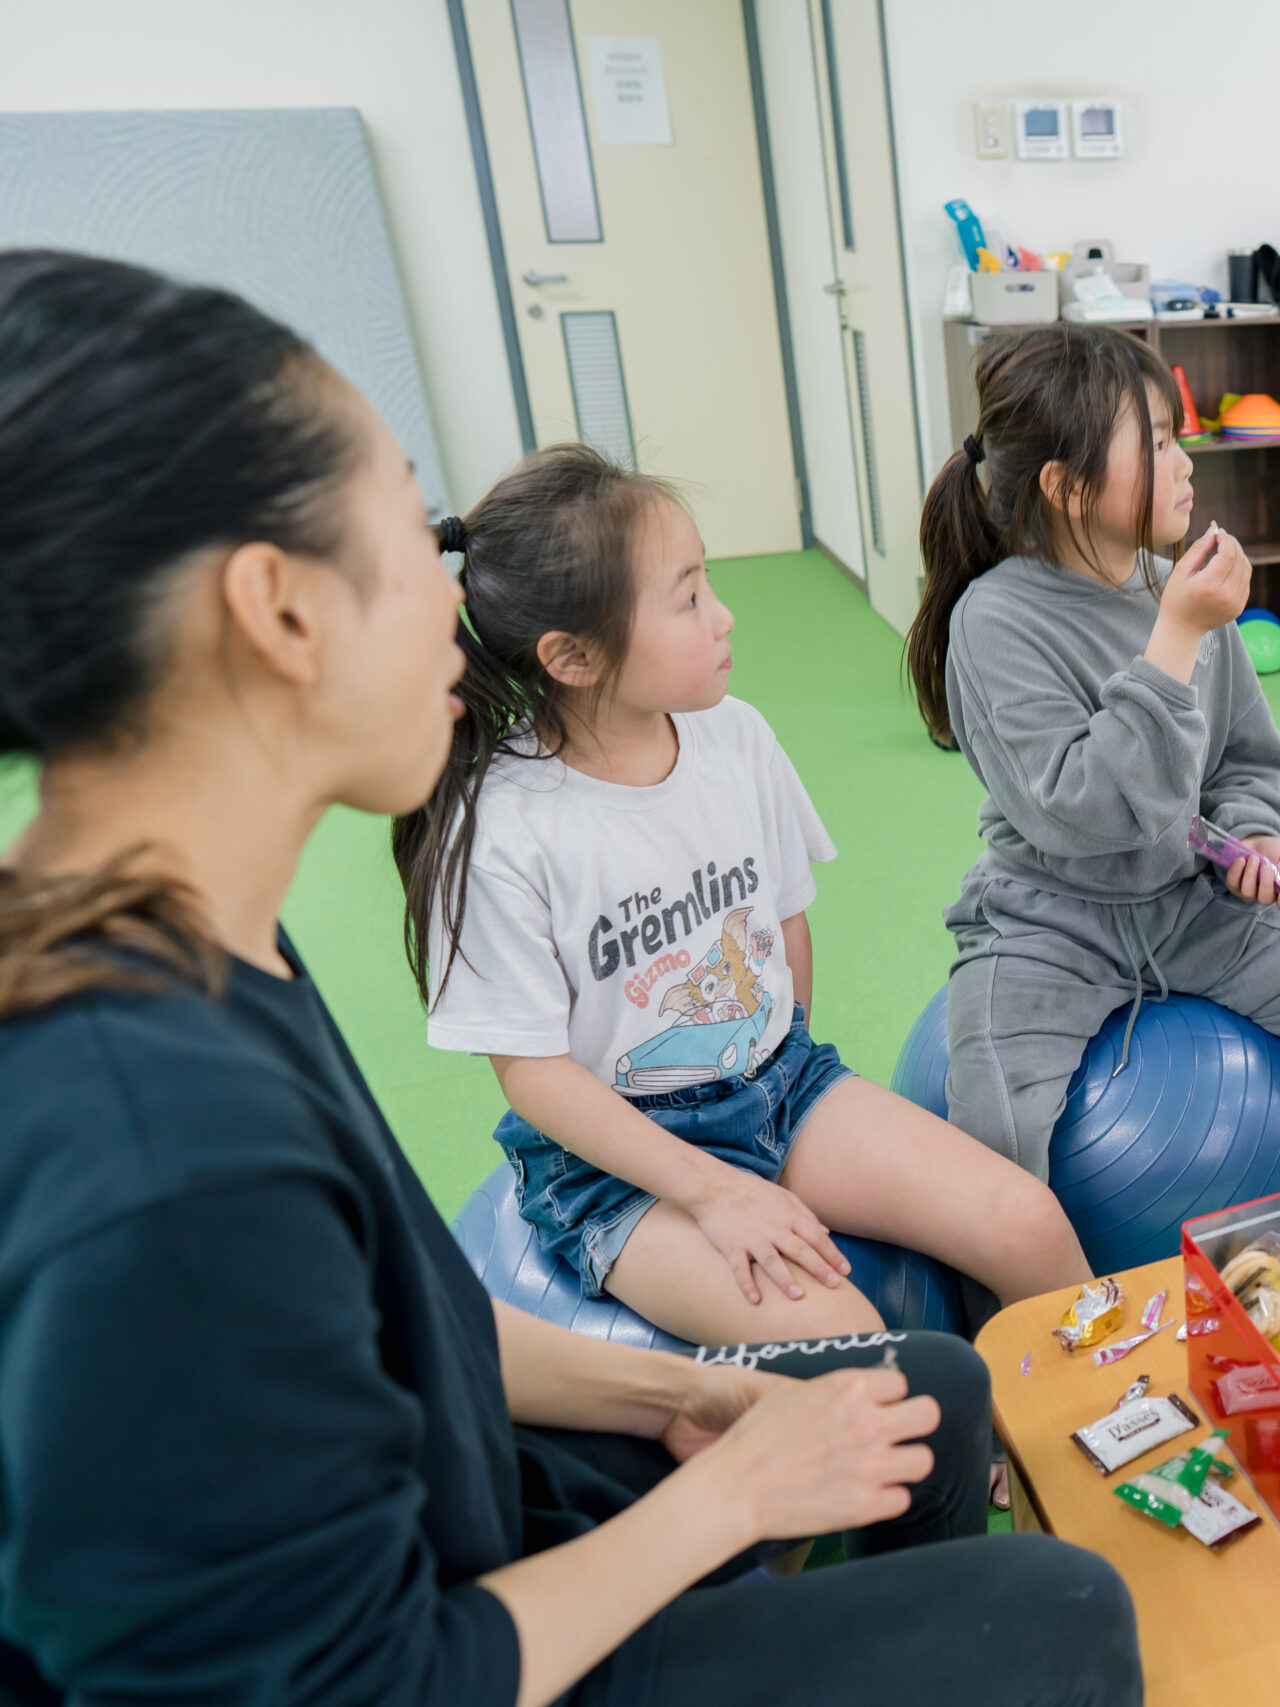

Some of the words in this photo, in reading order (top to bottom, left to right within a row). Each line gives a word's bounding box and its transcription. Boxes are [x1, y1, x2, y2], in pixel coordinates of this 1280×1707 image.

[588, 856, 759, 982] Gremlins
[617, 886, 662, 923] The
[624, 949, 691, 1009] Gizmo
